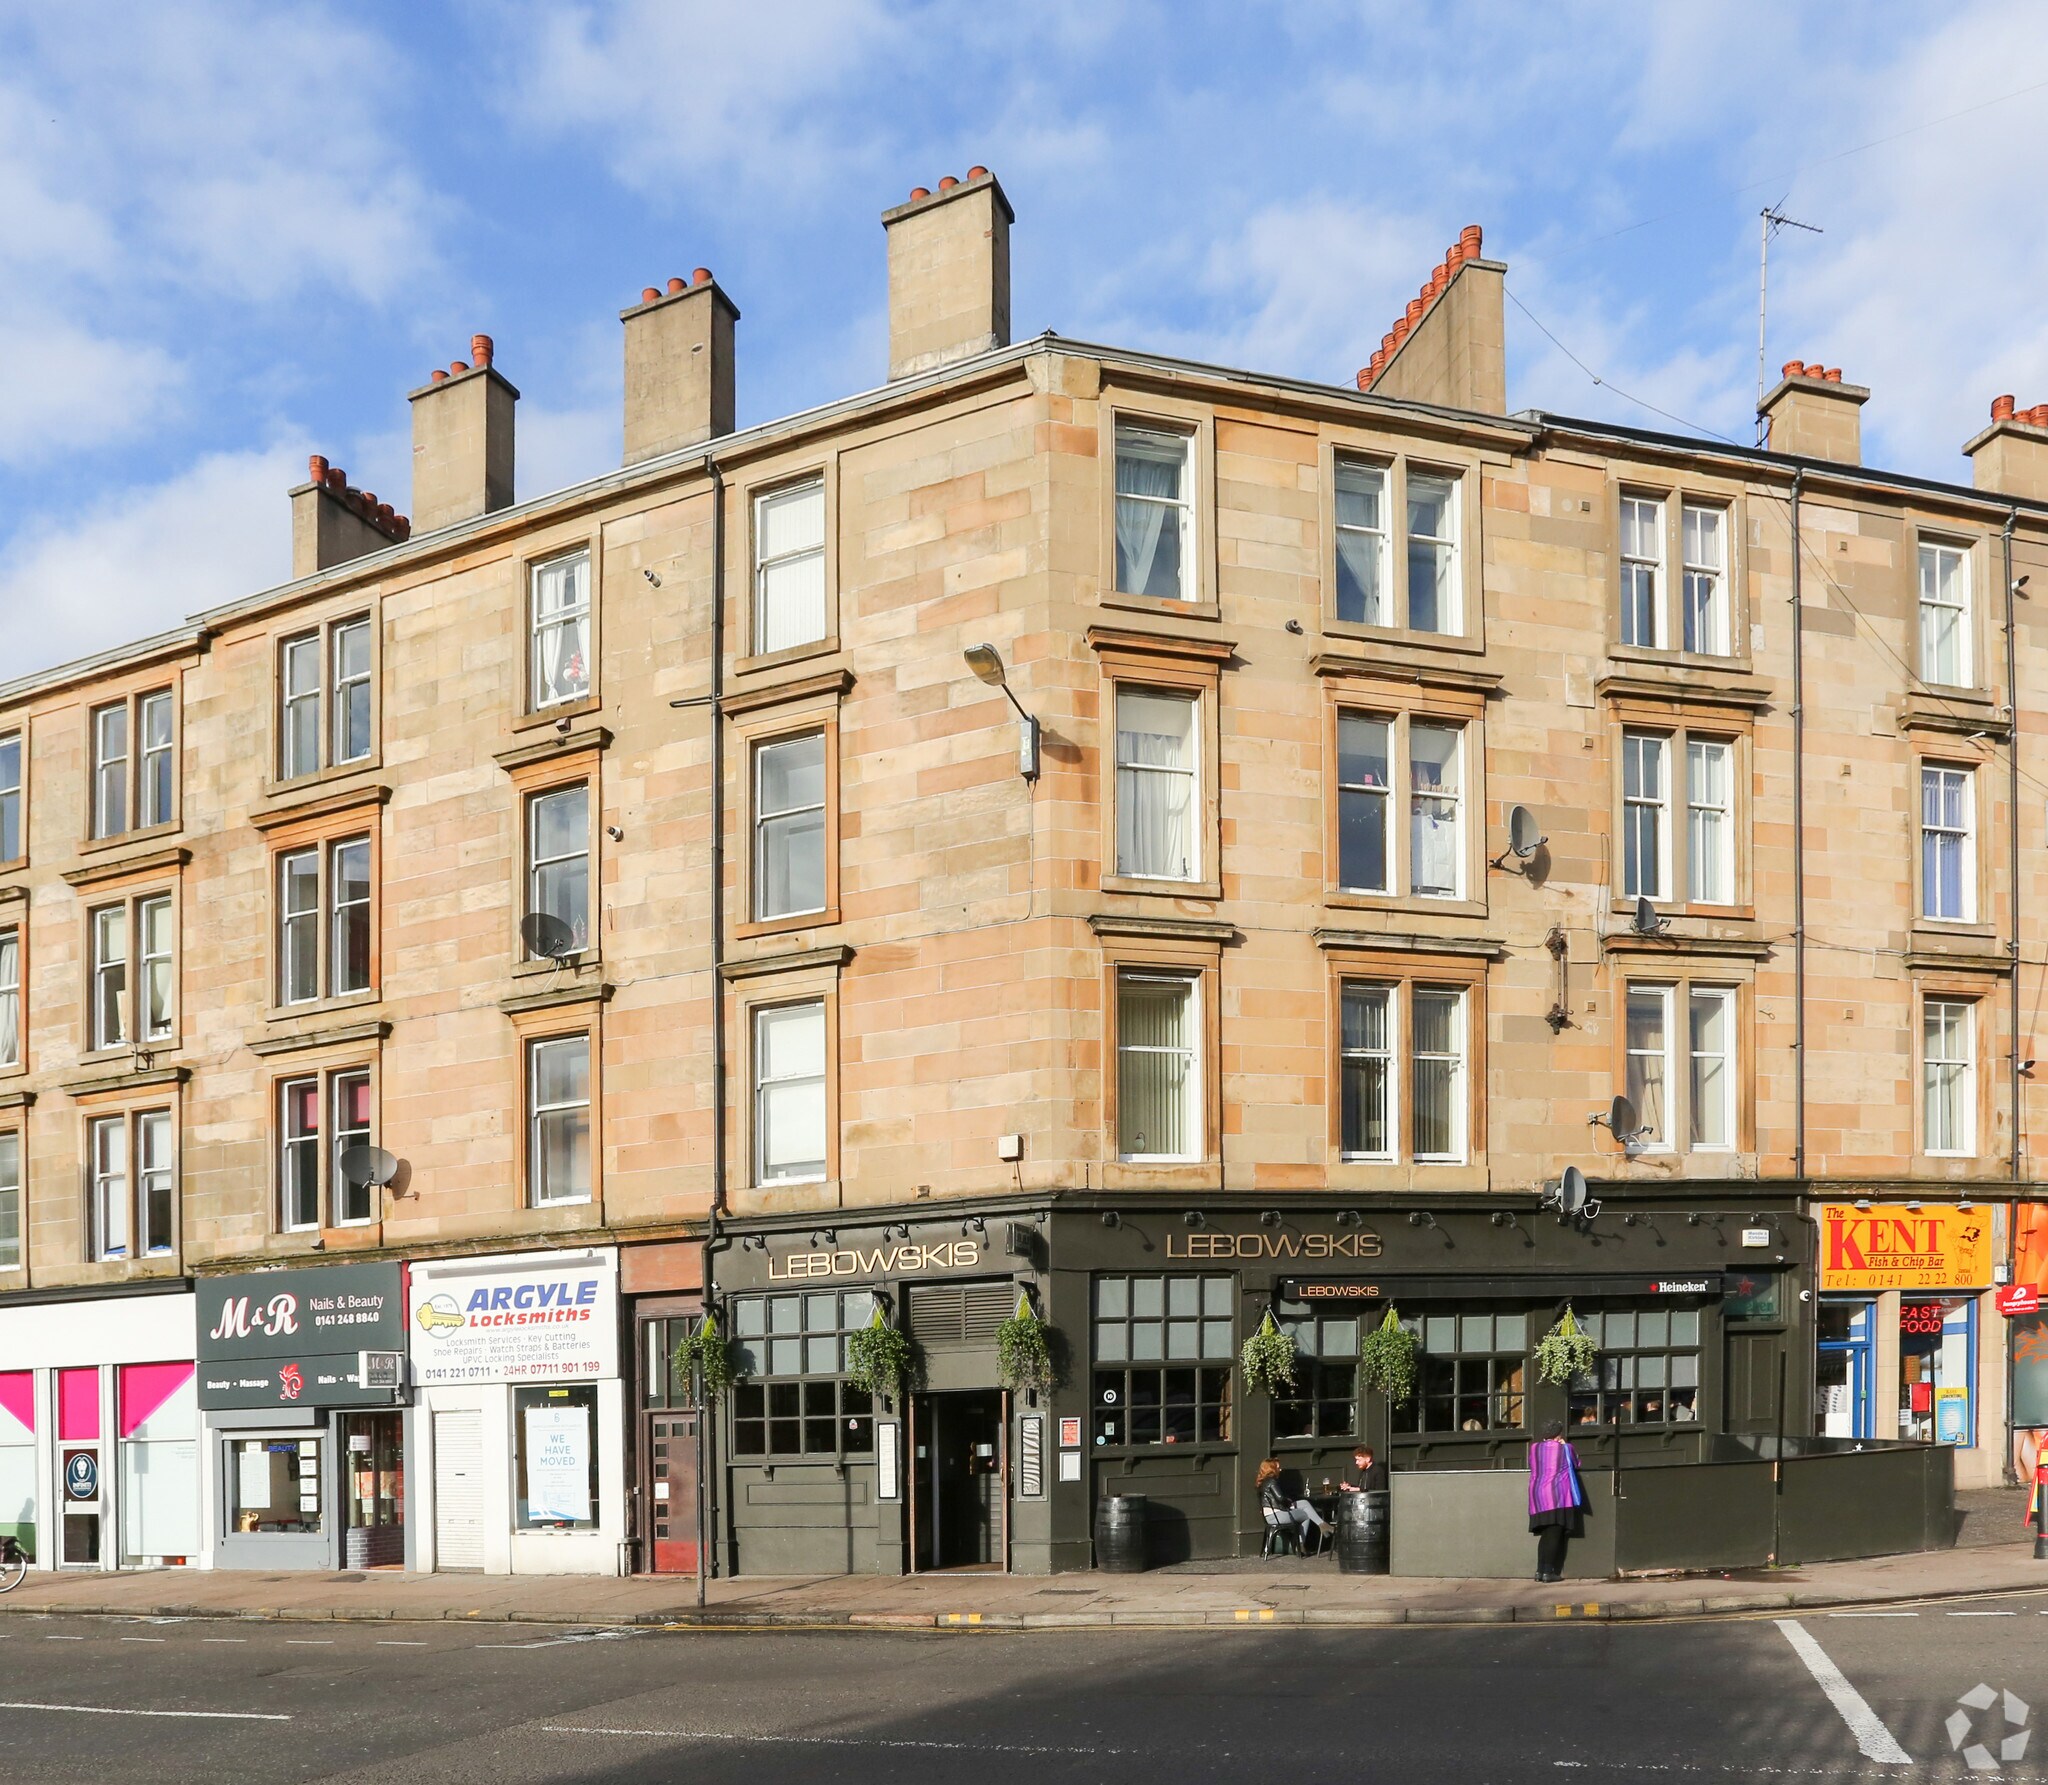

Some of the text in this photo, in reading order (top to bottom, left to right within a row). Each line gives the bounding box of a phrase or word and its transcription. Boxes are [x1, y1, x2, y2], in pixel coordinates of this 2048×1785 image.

[1826, 1208, 1844, 1219] The
[1166, 1233, 1383, 1259] LEBOWSKIS
[1826, 1219, 1945, 1271] KENT
[768, 1241, 980, 1280] LEBOWSKIS
[1868, 1256, 1944, 1269] Fish & Chip Bar
[1826, 1273, 1972, 1287] Tel: 0141 22 22 800
[1299, 1286, 1379, 1297] LEBOWSKIS
[1658, 1282, 1706, 1293] Heineken
[309, 1295, 384, 1311] Nails & Beauty
[466, 1280, 598, 1312] ARGYLE
[315, 1312, 380, 1326] 0141 248 8840
[469, 1308, 591, 1328] Locksmiths
[1900, 1306, 1941, 1319] FAST
[1900, 1320, 1941, 1333] FOOD
[446, 1333, 576, 1347] Locksmith Services Key Cutting
[434, 1341, 591, 1357] Shoe Repairs Watch Straps & Batteries
[463, 1352, 559, 1364] UPVC Locking Specialists
[426, 1361, 600, 1379] 0141 221 0711 24HR 07711 901 199
[207, 1380, 230, 1390] Beauty
[239, 1379, 269, 1389] Massage
[318, 1375, 336, 1385] Nails
[550, 1434, 565, 1443] WE
[268, 1444, 296, 1452] BEAUTY
[545, 1445, 571, 1455] HAVE
[540, 1457, 575, 1466] MOVED
